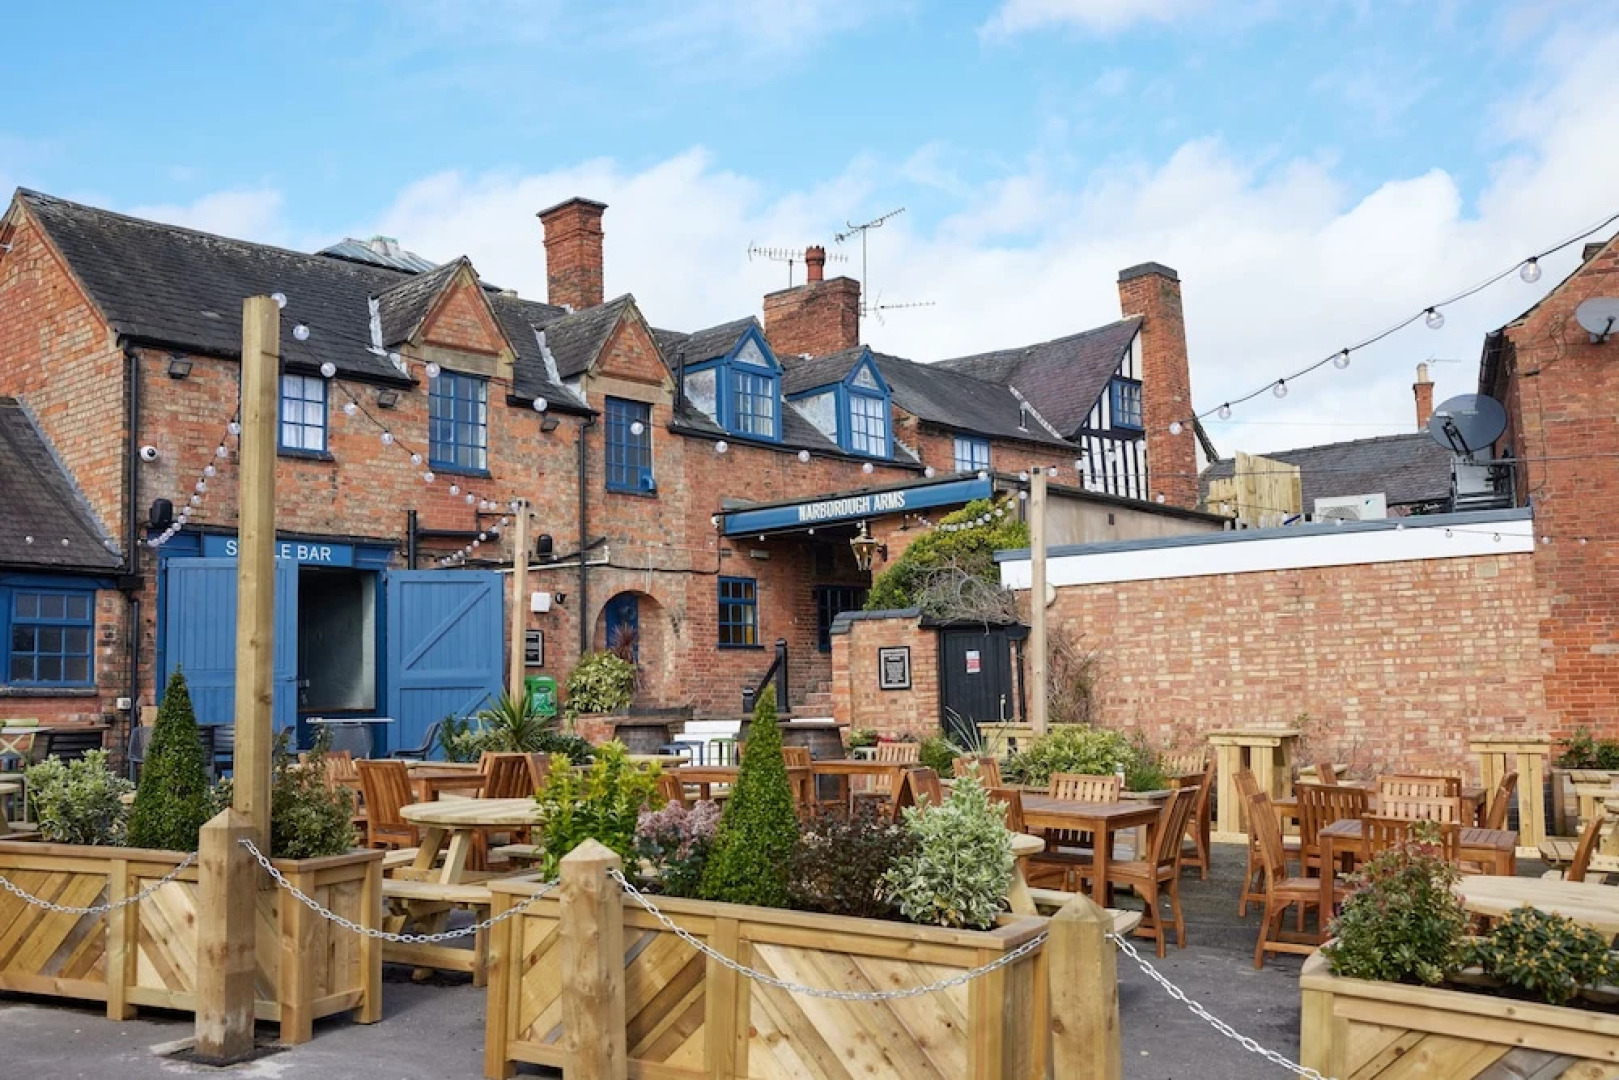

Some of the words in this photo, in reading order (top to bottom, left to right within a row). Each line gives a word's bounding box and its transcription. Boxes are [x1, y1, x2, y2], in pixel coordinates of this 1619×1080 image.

[799, 494, 870, 521] NARBOROUGH
[874, 490, 906, 511] ARMS
[298, 545, 331, 561] BAR
